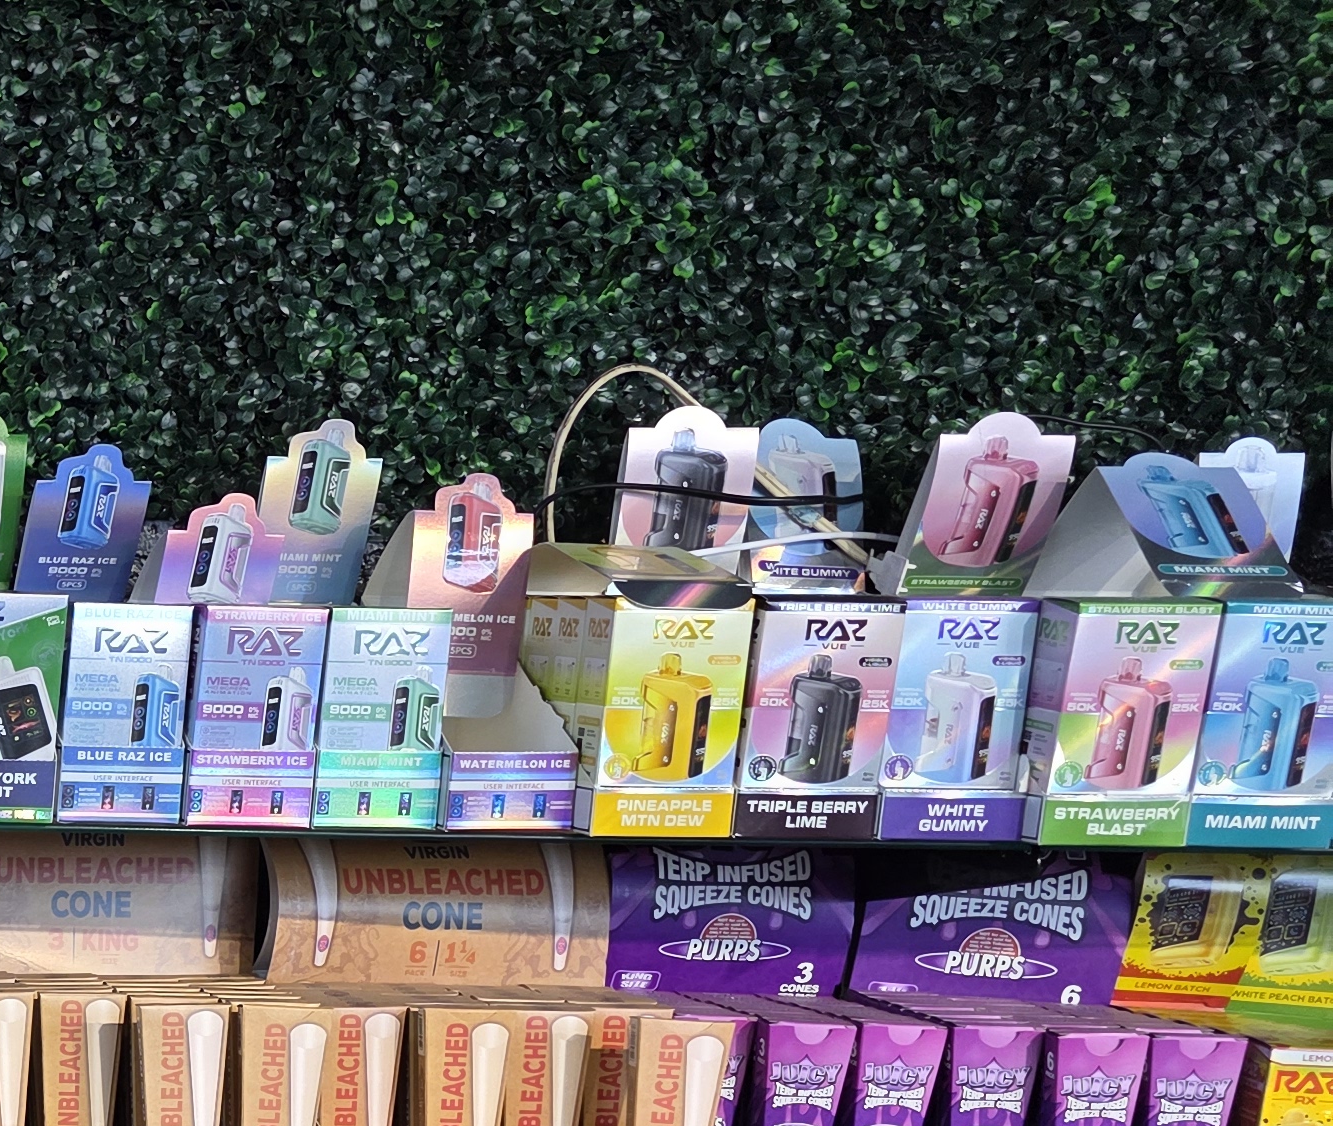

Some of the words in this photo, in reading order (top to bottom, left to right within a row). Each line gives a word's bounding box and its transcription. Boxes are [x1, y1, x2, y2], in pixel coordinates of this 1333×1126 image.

[225, 626, 304, 656] RAZ
[196, 755, 283, 766] STRAWBERRY
[286, 756, 308, 766] ICE
[460, 758, 546, 769] WATERMELON
[549, 758, 571, 769] ICE
[616, 799, 712, 812] PINEAPPLE
[747, 801, 805, 814] TRIPLE
[810, 801, 869, 814] BERRY
[621, 814, 656, 826] MTN
[660, 813, 704, 826] DEW
[1054, 808, 1179, 821] STRAWBERRY
[785, 816, 827, 829] LIME
[1087, 822, 1145, 836] BLAST
[1205, 816, 1265, 830] MIAMI
[1270, 816, 1321, 830] MINT
[51, 889, 132, 919] CONE
[653, 886, 745, 918] SQUEEZE
[751, 885, 812, 918] CONES
[687, 939, 762, 961] PURPS
[1134, 982, 1170, 991] LEMON
[1173, 984, 1210, 993] BATCH
